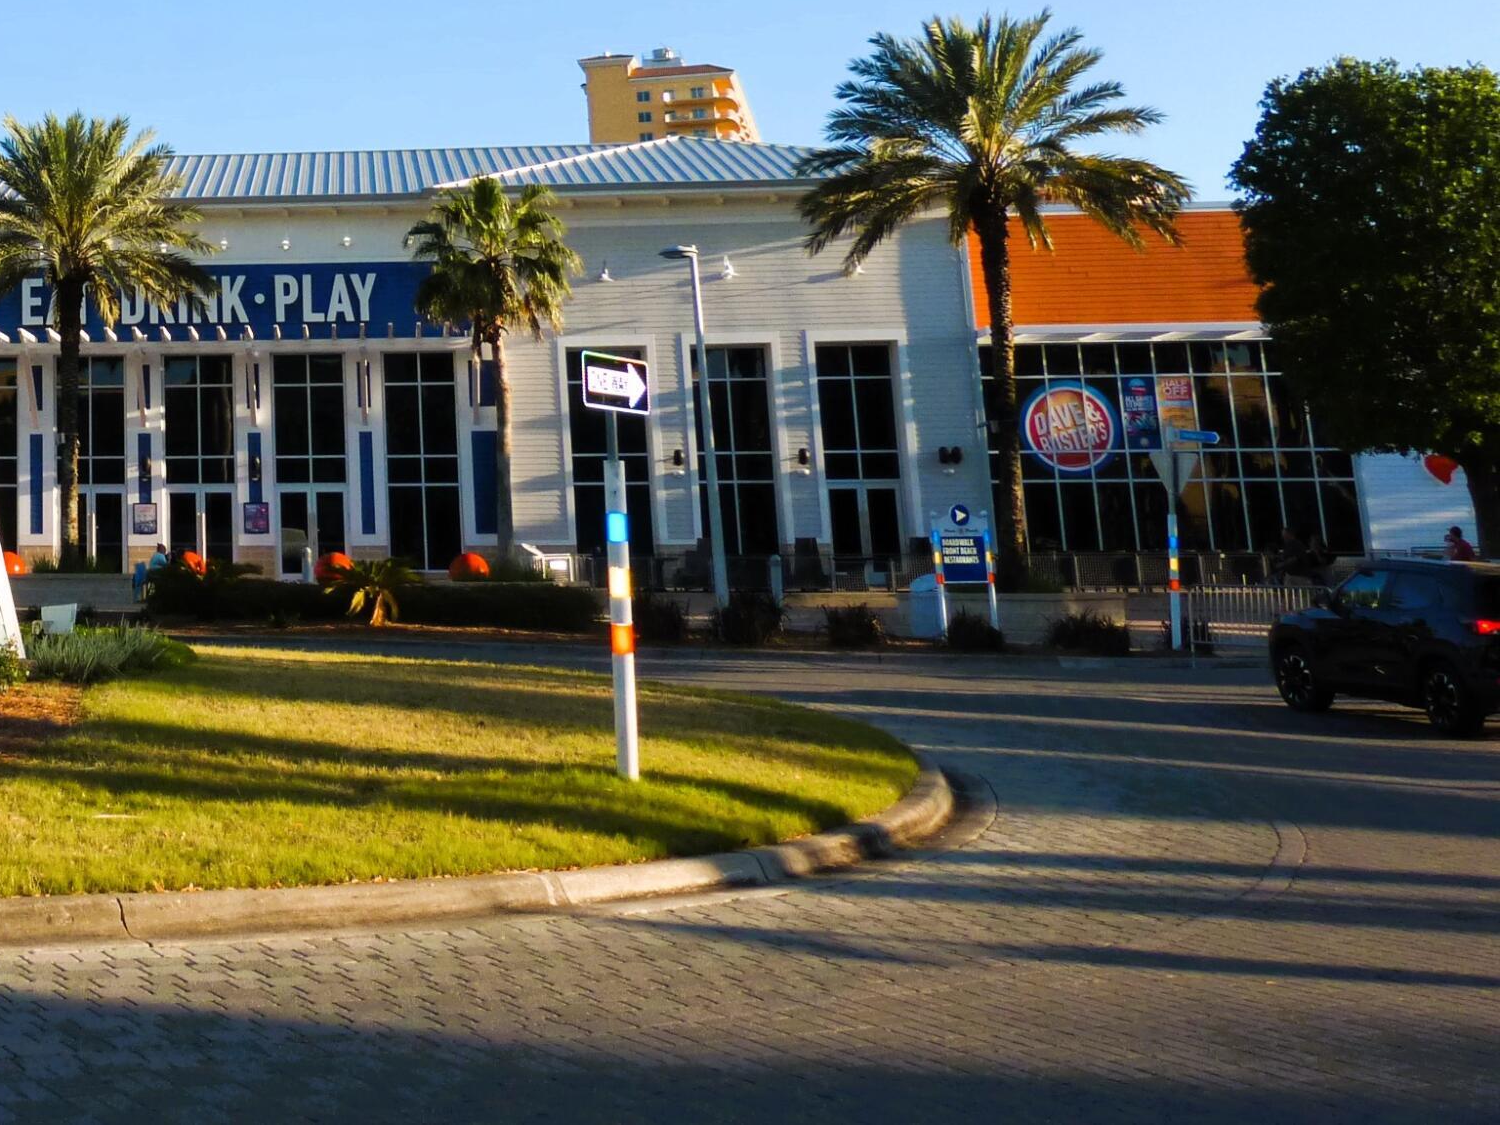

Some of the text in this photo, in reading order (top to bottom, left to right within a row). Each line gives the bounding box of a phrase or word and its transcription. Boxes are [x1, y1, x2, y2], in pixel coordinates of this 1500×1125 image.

[273, 273, 377, 323] PLAY
[1163, 386, 1189, 396] OFF
[1034, 400, 1104, 436] DAVE &
[1039, 422, 1108, 453] BUSTER'S
